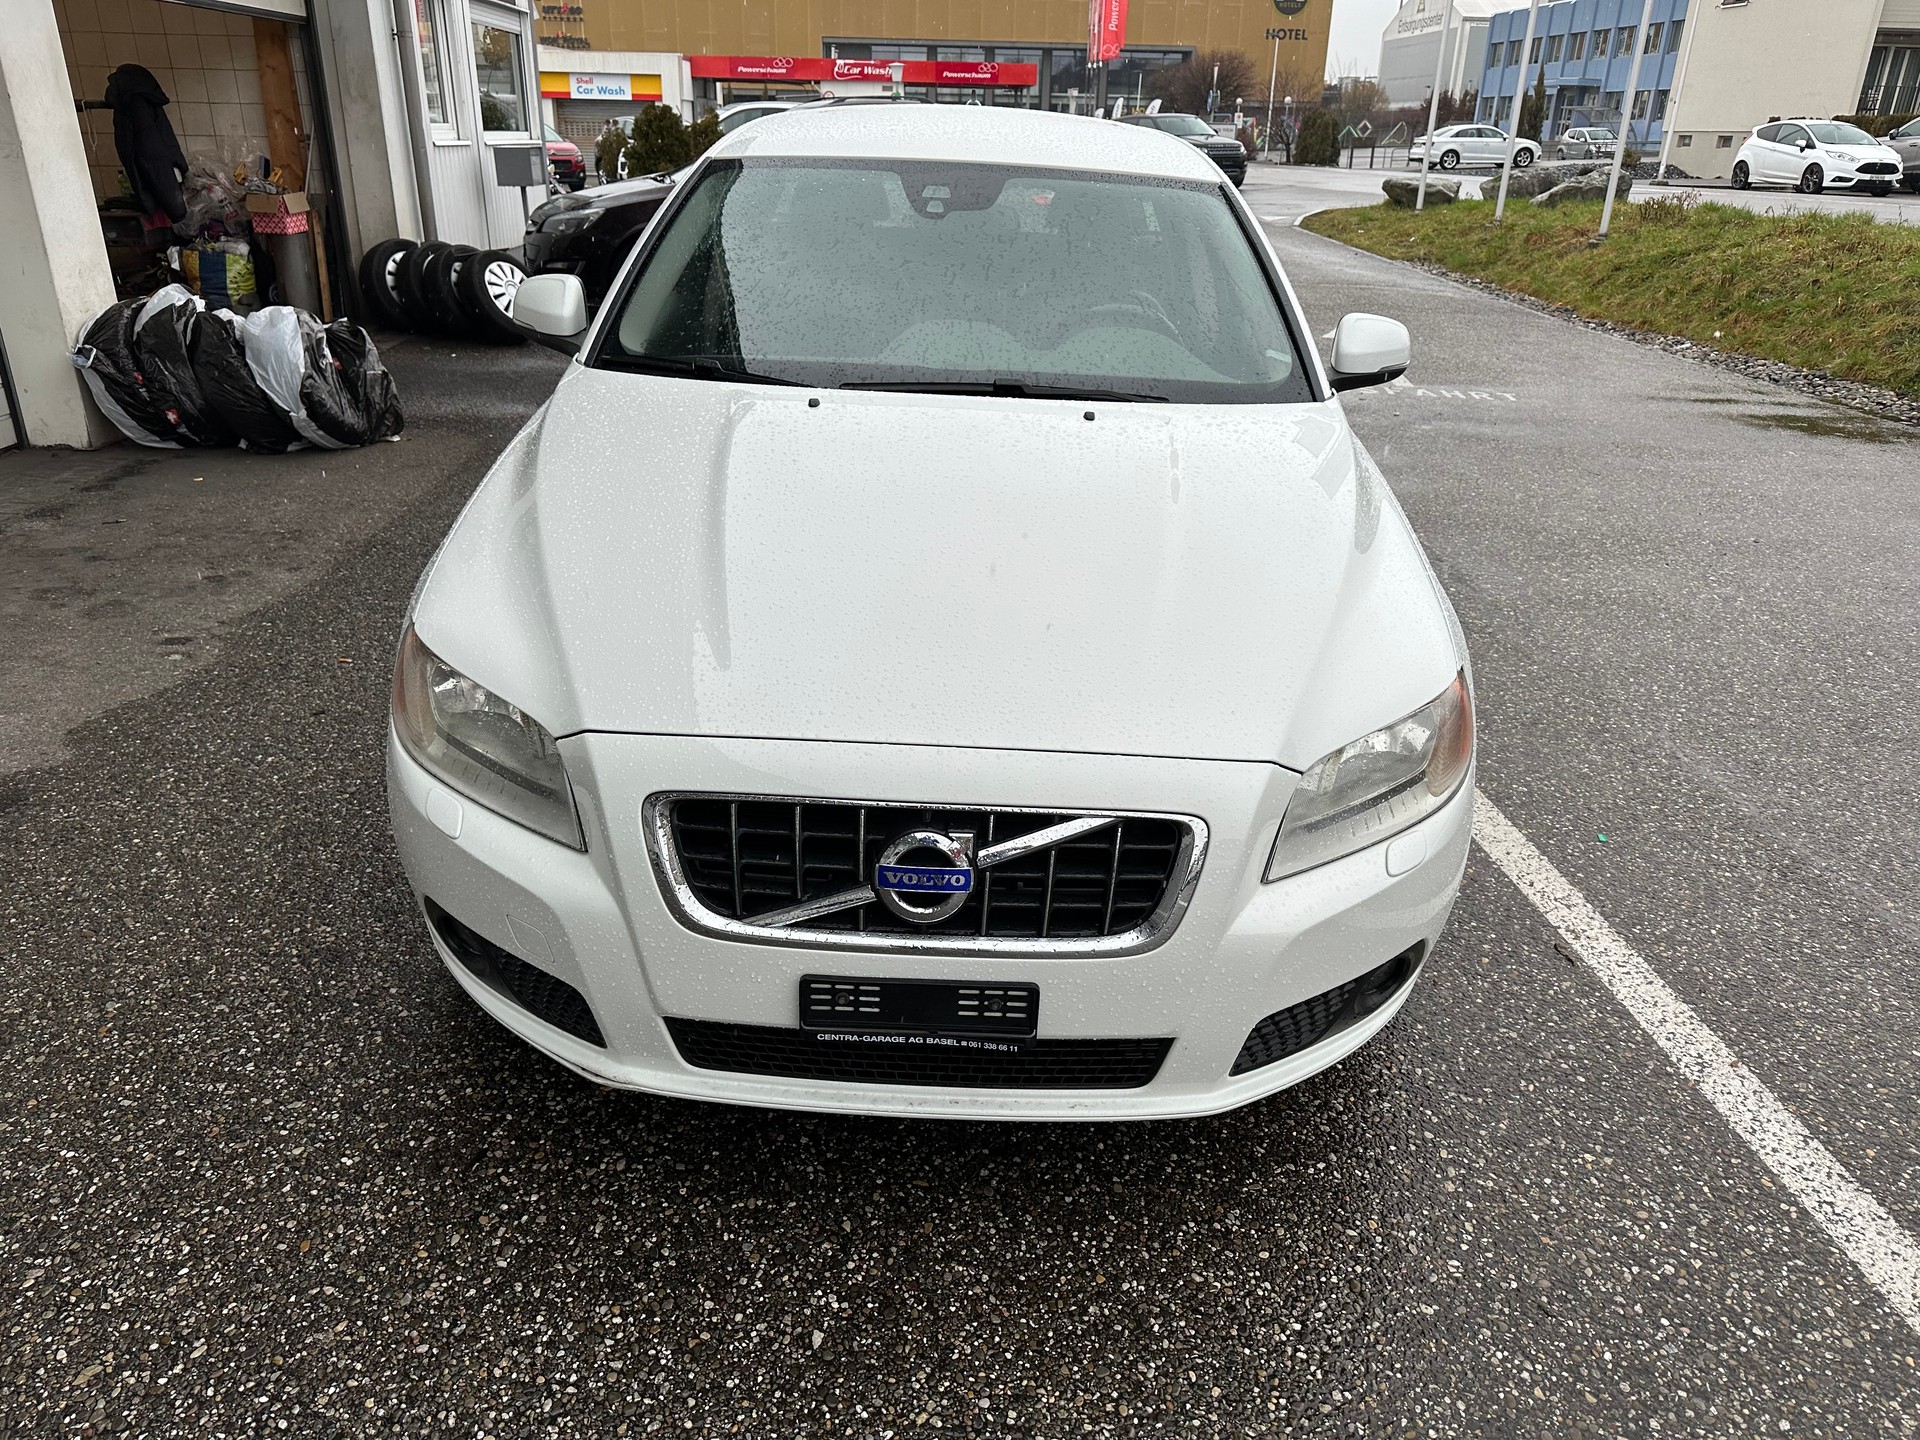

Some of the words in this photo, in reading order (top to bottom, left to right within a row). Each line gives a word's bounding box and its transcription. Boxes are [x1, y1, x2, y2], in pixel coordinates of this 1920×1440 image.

[1397, 13, 1443, 34] Entsorgungscenter
[1265, 28, 1308, 41] HOTEL
[737, 66, 787, 74] Powerschaum
[844, 66, 862, 74] Car
[864, 66, 892, 75] Wash
[942, 71, 992, 79] Powerschaum
[575, 77, 594, 85] Shell
[576, 85, 594, 95] Car
[597, 86, 625, 95] Wash
[883, 871, 966, 887] VOLVO
[817, 1033, 906, 1043] CENTRA-GARAGE
[908, 1036, 924, 1044] AG
[926, 1036, 960, 1046] BASEL
[968, 1040, 982, 1049] 061
[983, 1042, 997, 1050] 338
[1010, 1045, 1018, 1053] 11
